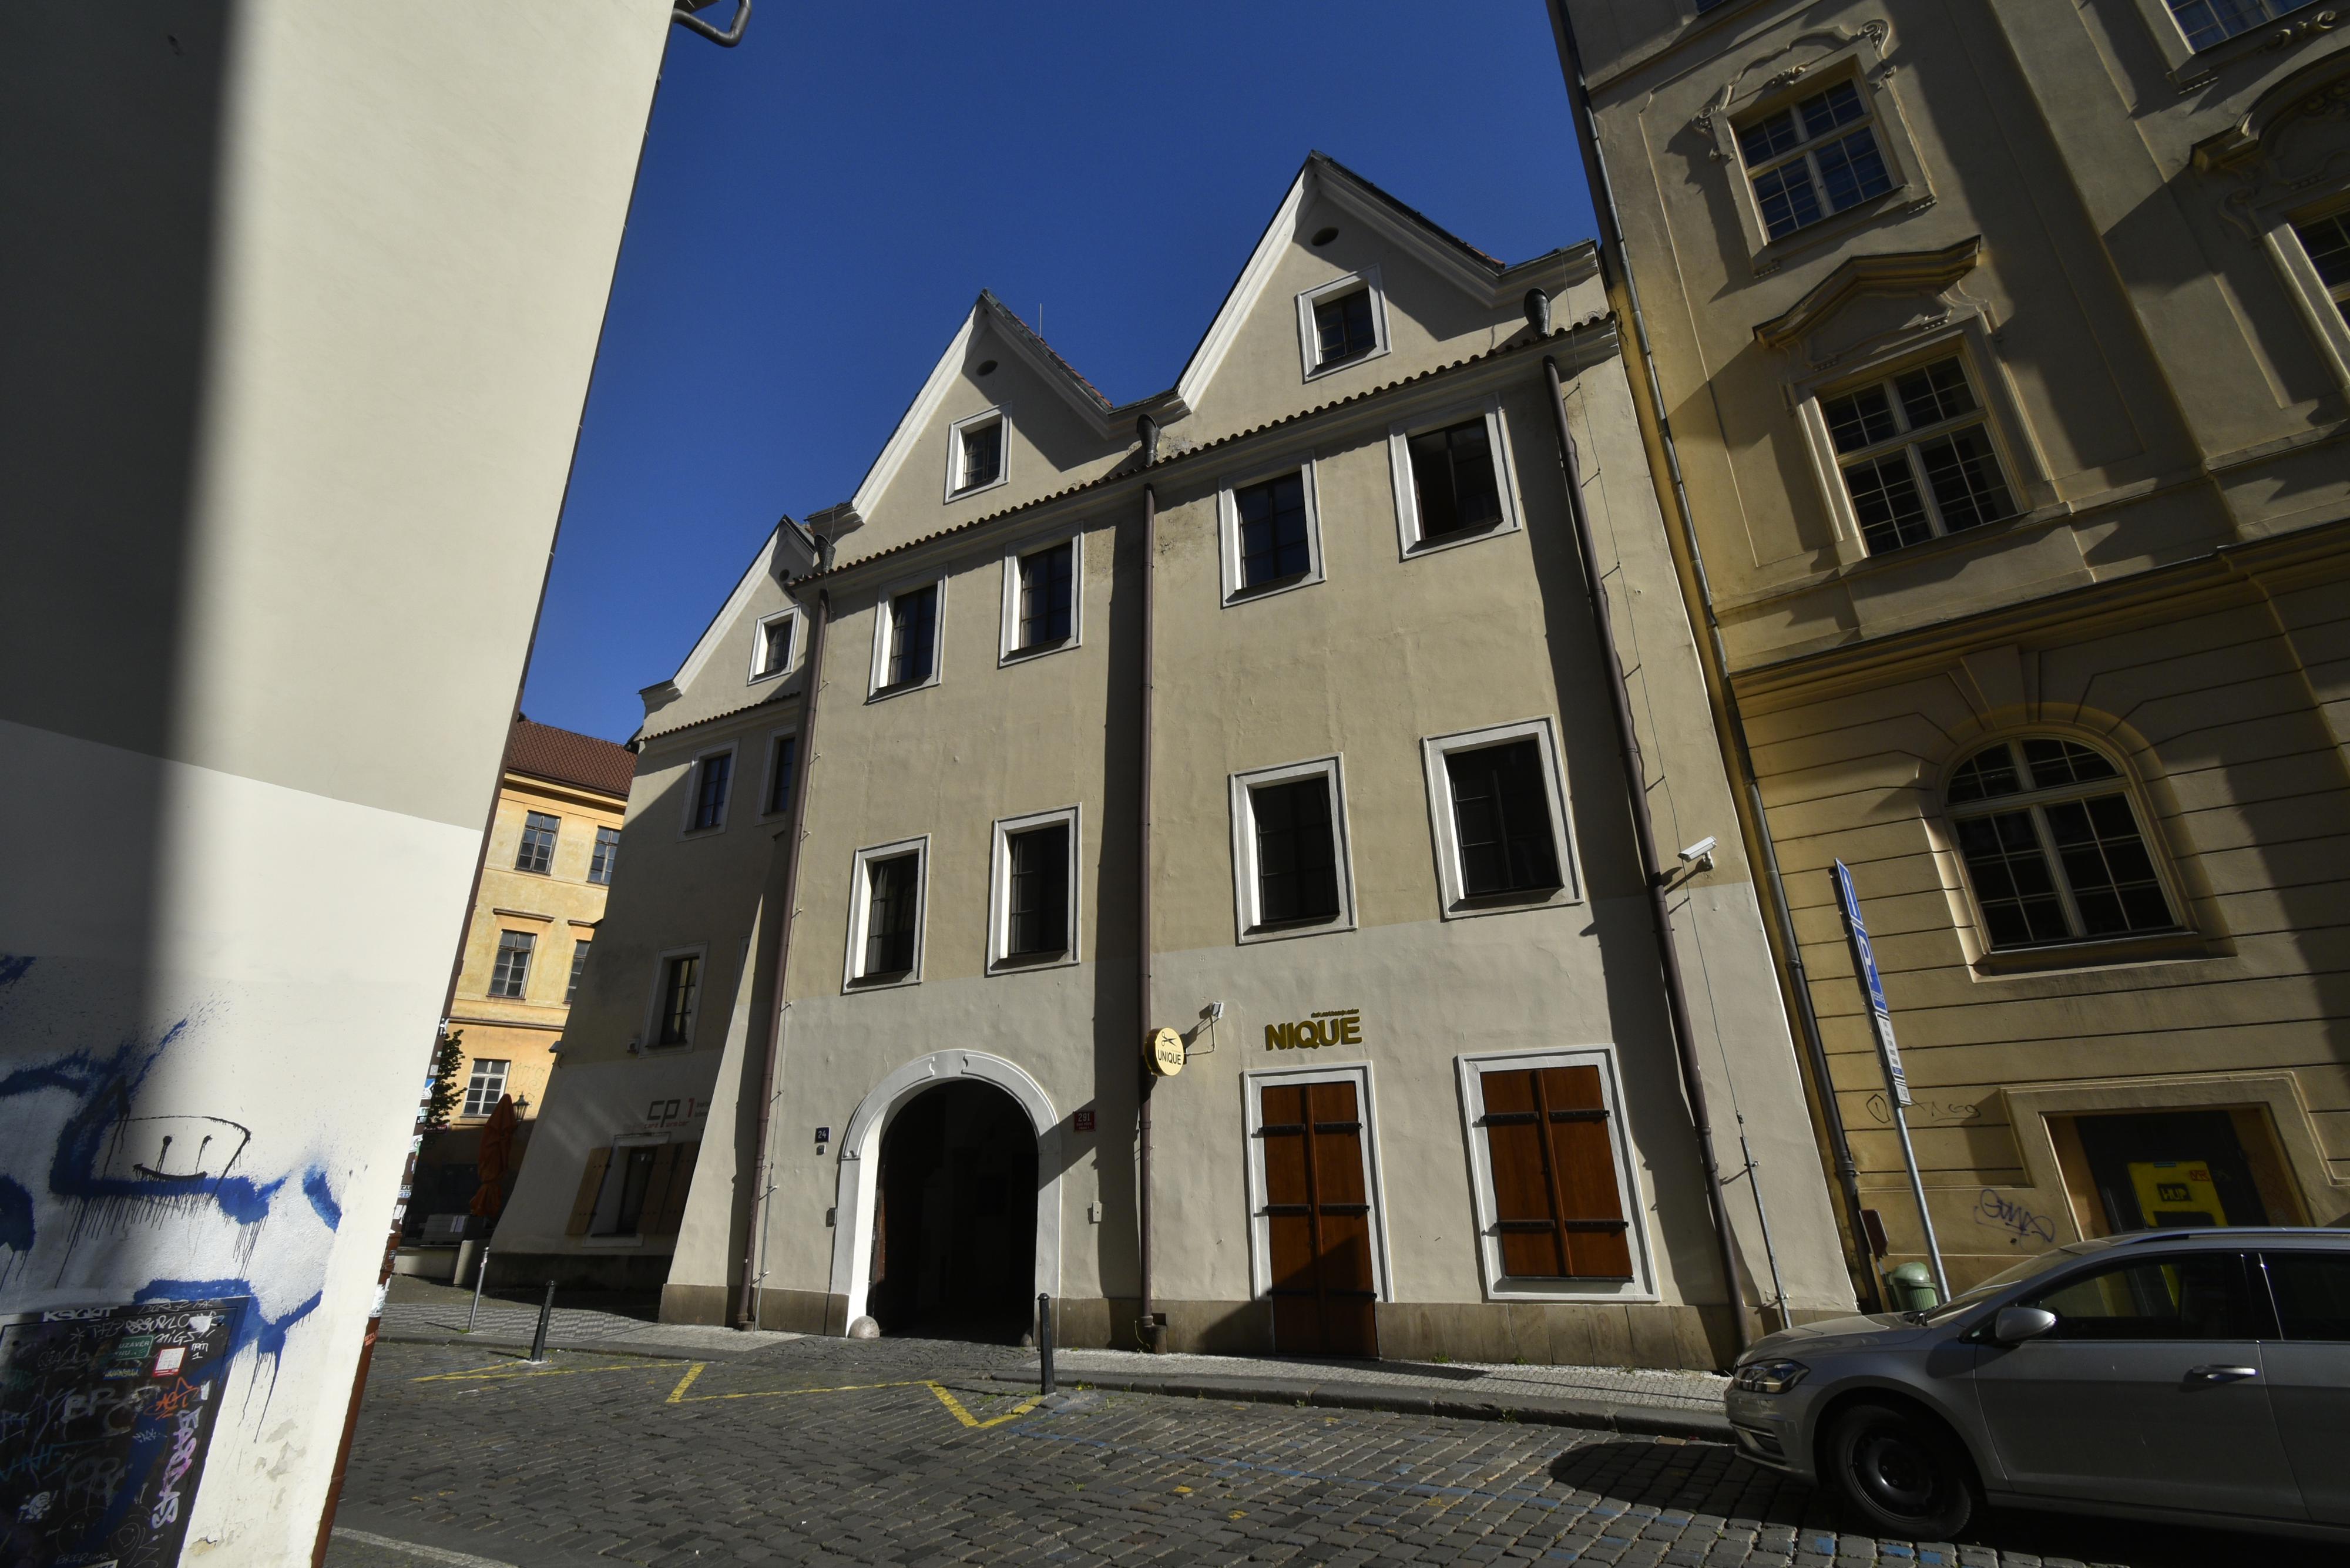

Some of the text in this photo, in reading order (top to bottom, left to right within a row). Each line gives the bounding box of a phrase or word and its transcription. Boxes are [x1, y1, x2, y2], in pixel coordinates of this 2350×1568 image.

[1265, 1016, 1362, 1051] NIQUE
[1158, 1049, 1181, 1065] UNIQUE
[1078, 1112, 1090, 1122] 291
[818, 1130, 827, 1139] 24
